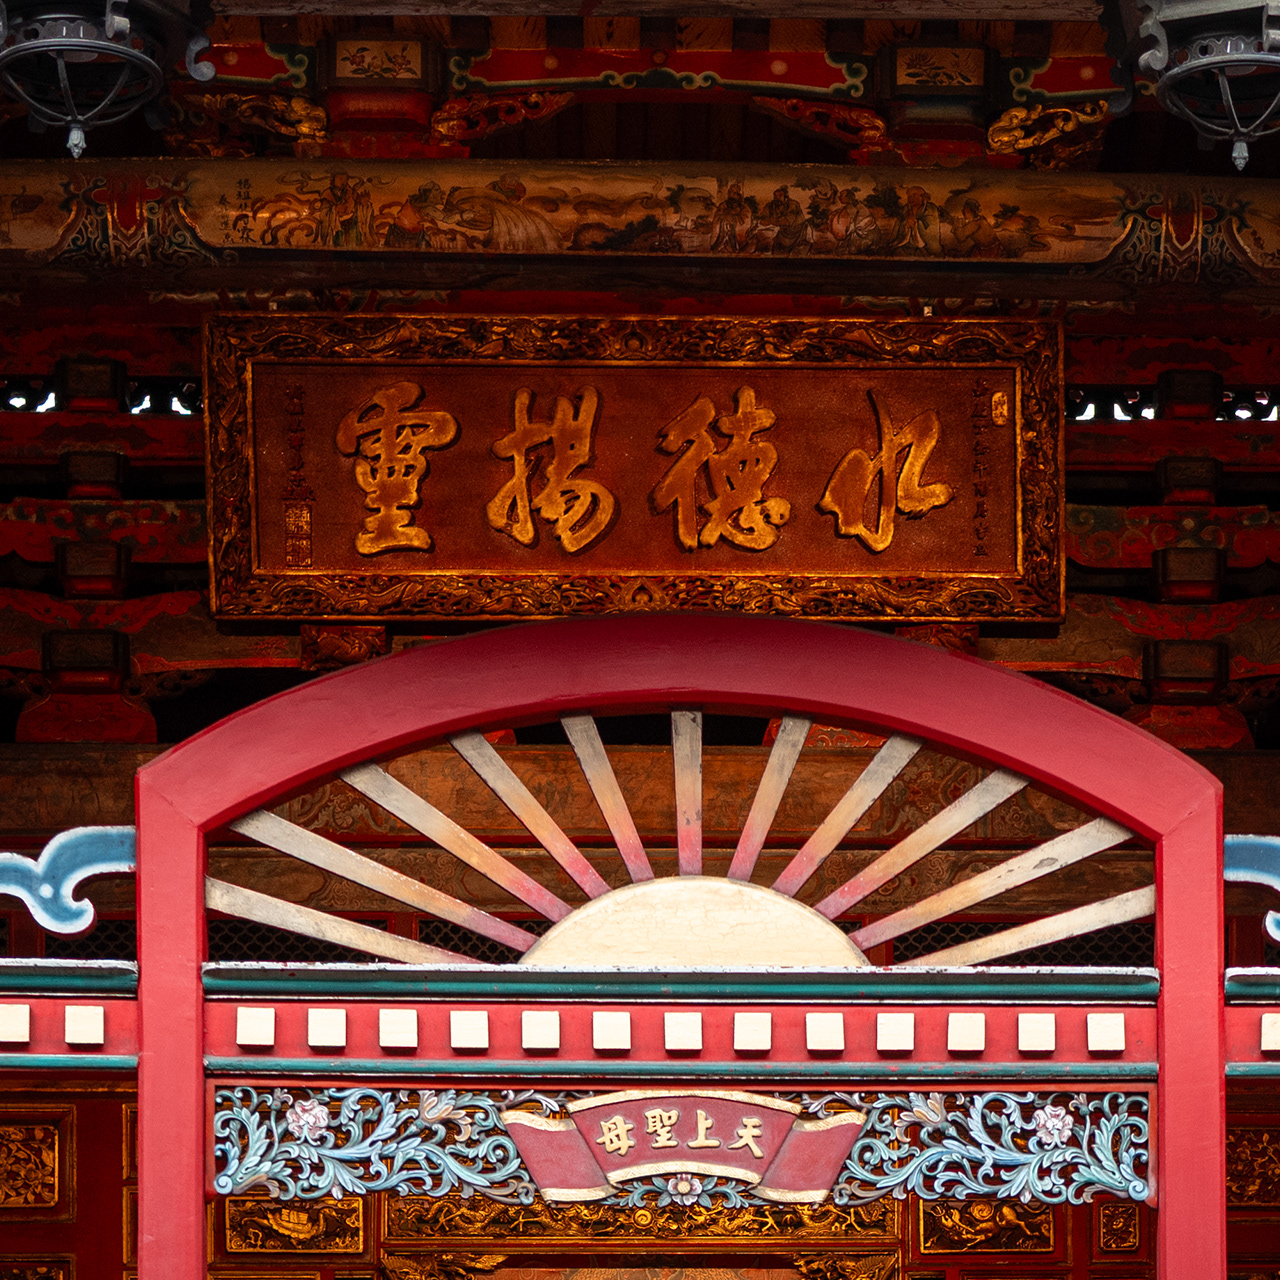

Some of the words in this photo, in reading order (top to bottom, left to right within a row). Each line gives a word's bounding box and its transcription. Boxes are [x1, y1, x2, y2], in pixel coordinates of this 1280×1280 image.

[336, 379, 956, 557] 水德揚靈
[596, 1108, 764, 1159] 天上聖母
